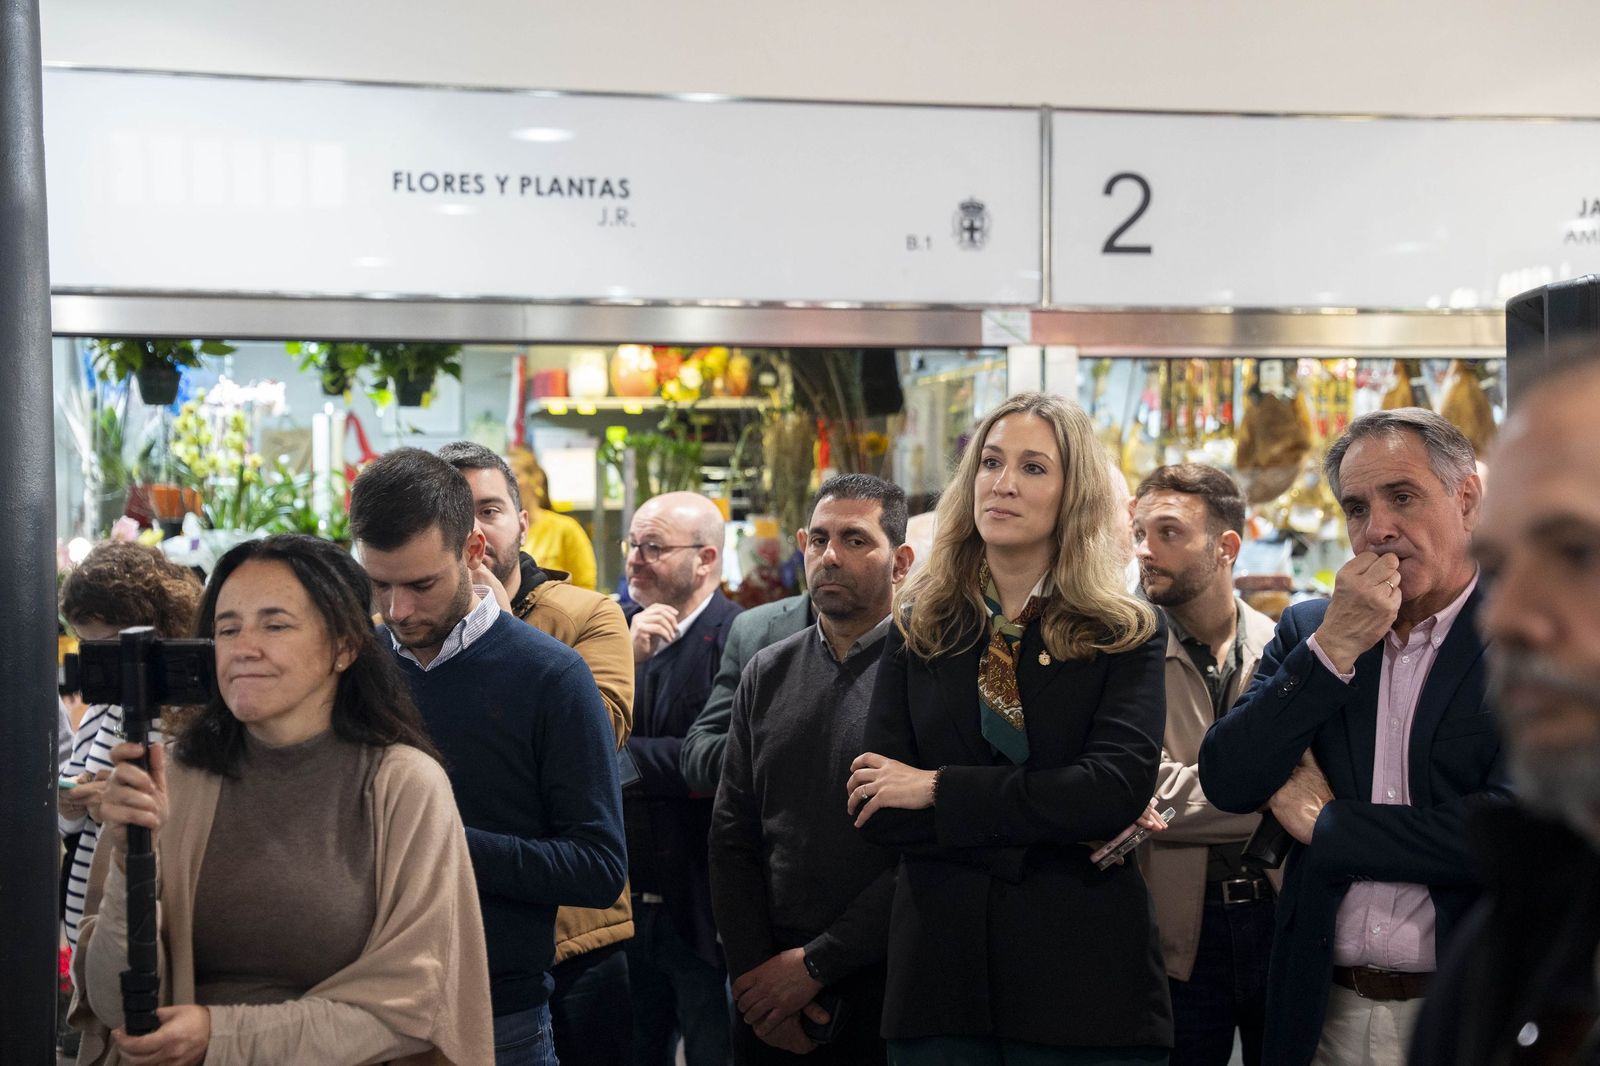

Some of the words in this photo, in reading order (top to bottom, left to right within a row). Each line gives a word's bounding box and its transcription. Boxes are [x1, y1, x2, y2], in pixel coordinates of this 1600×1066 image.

[393, 171, 485, 194] FLORES
[496, 175, 509, 195] Y
[519, 176, 631, 199] PLANTAS
[597, 207, 636, 228] J.R.
[1101, 171, 1153, 254] 2
[1563, 229, 1600, 245] AM
